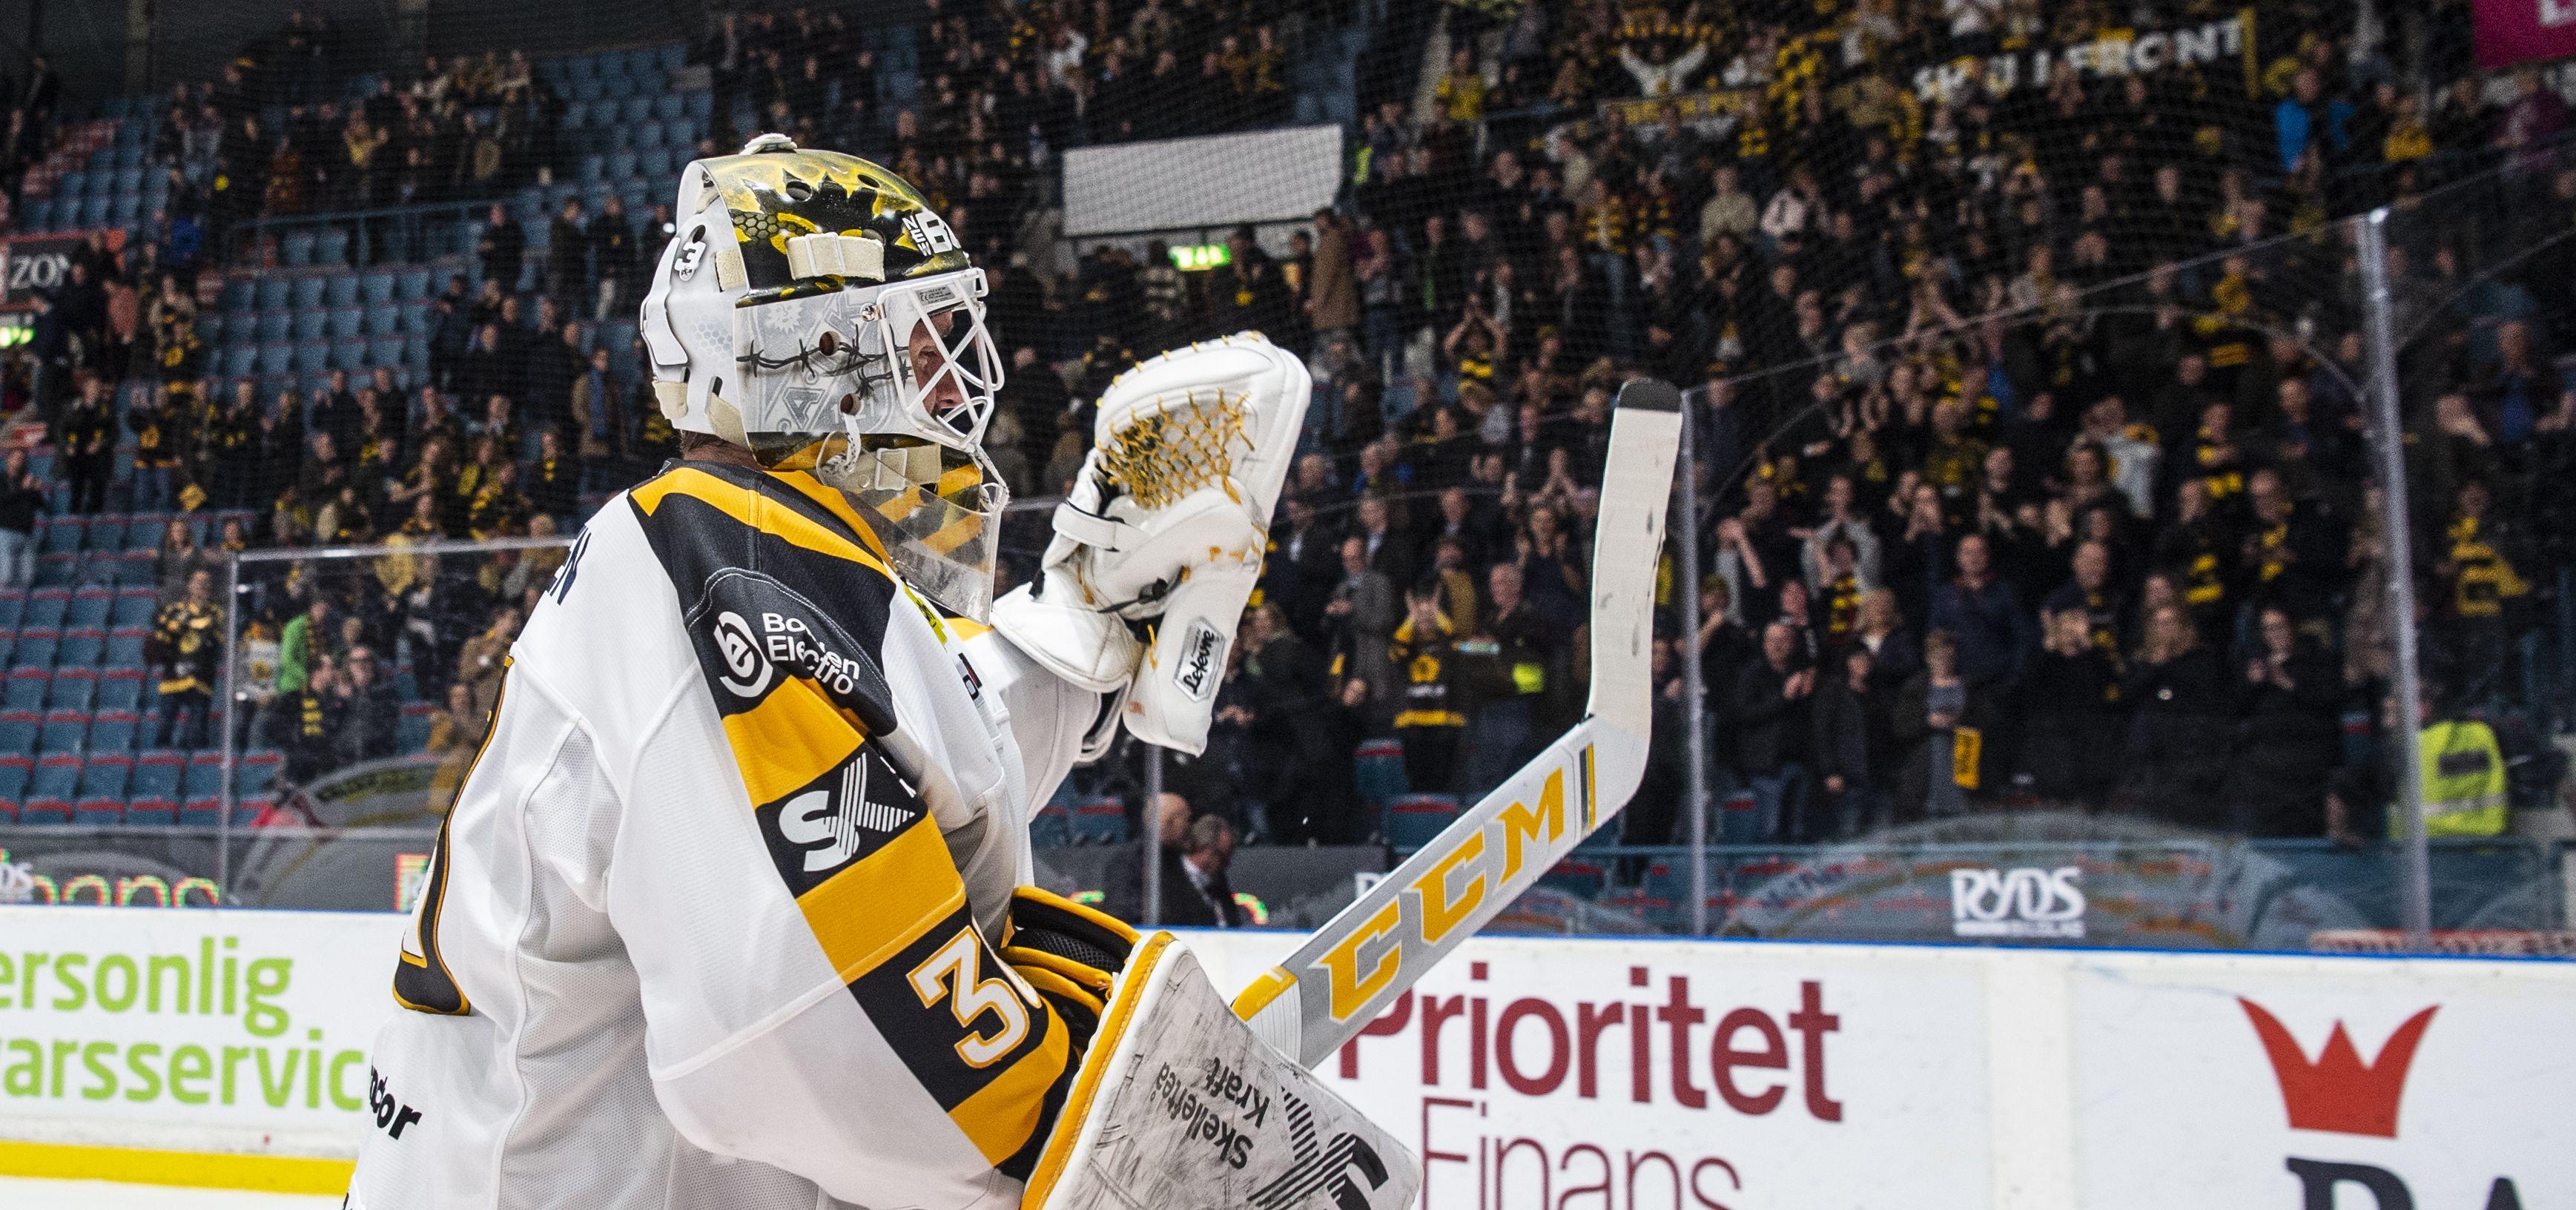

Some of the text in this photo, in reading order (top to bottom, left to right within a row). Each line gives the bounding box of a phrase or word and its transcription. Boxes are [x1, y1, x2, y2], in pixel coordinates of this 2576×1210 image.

[902, 215, 932, 257] NEW
[766, 635, 853, 695] Electro
[1317, 766, 1564, 1025] CCM
[0, 936, 294, 1037] ersonlig
[0, 1028, 365, 1111] arsservic
[1339, 961, 1844, 1123] Prioritet
[1149, 1060, 1254, 1170] Skellefteå
[1203, 1056, 1270, 1129] Kraft
